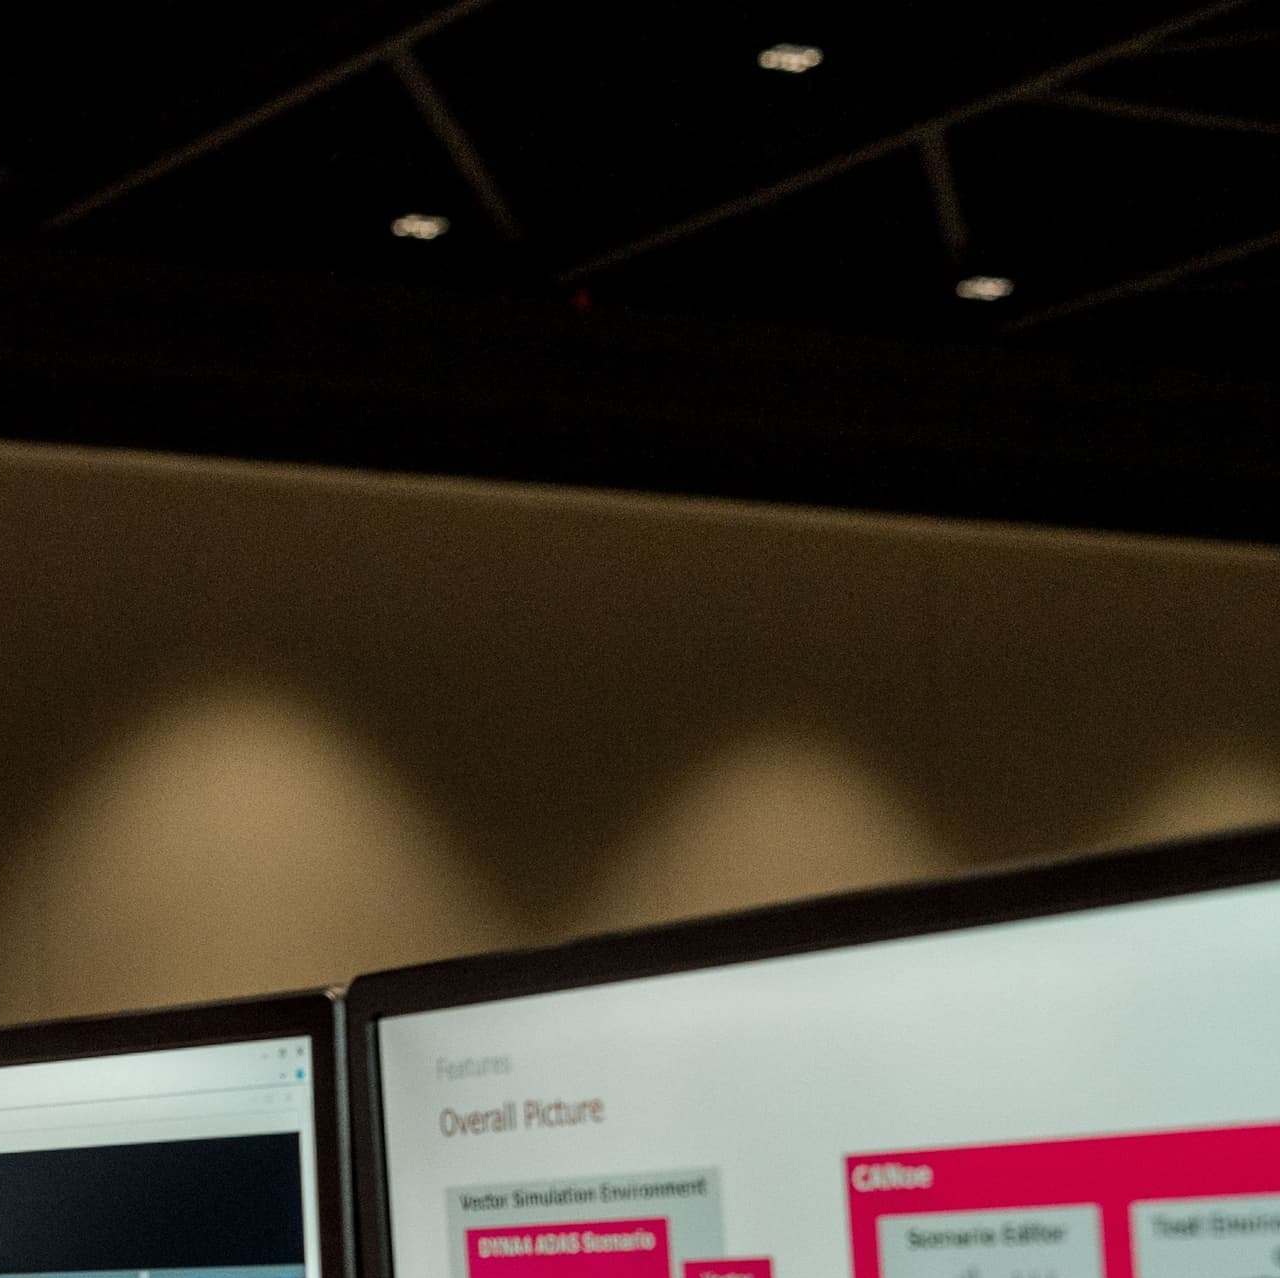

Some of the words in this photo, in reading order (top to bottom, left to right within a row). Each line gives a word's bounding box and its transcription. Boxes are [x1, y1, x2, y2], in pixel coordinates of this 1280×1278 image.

[440, 1103, 517, 1138] Overall
[524, 1097, 605, 1131] Picture
[460, 1192, 507, 1212] Vector
[512, 1186, 597, 1209] Simulation
[600, 1176, 708, 1204] Environment
